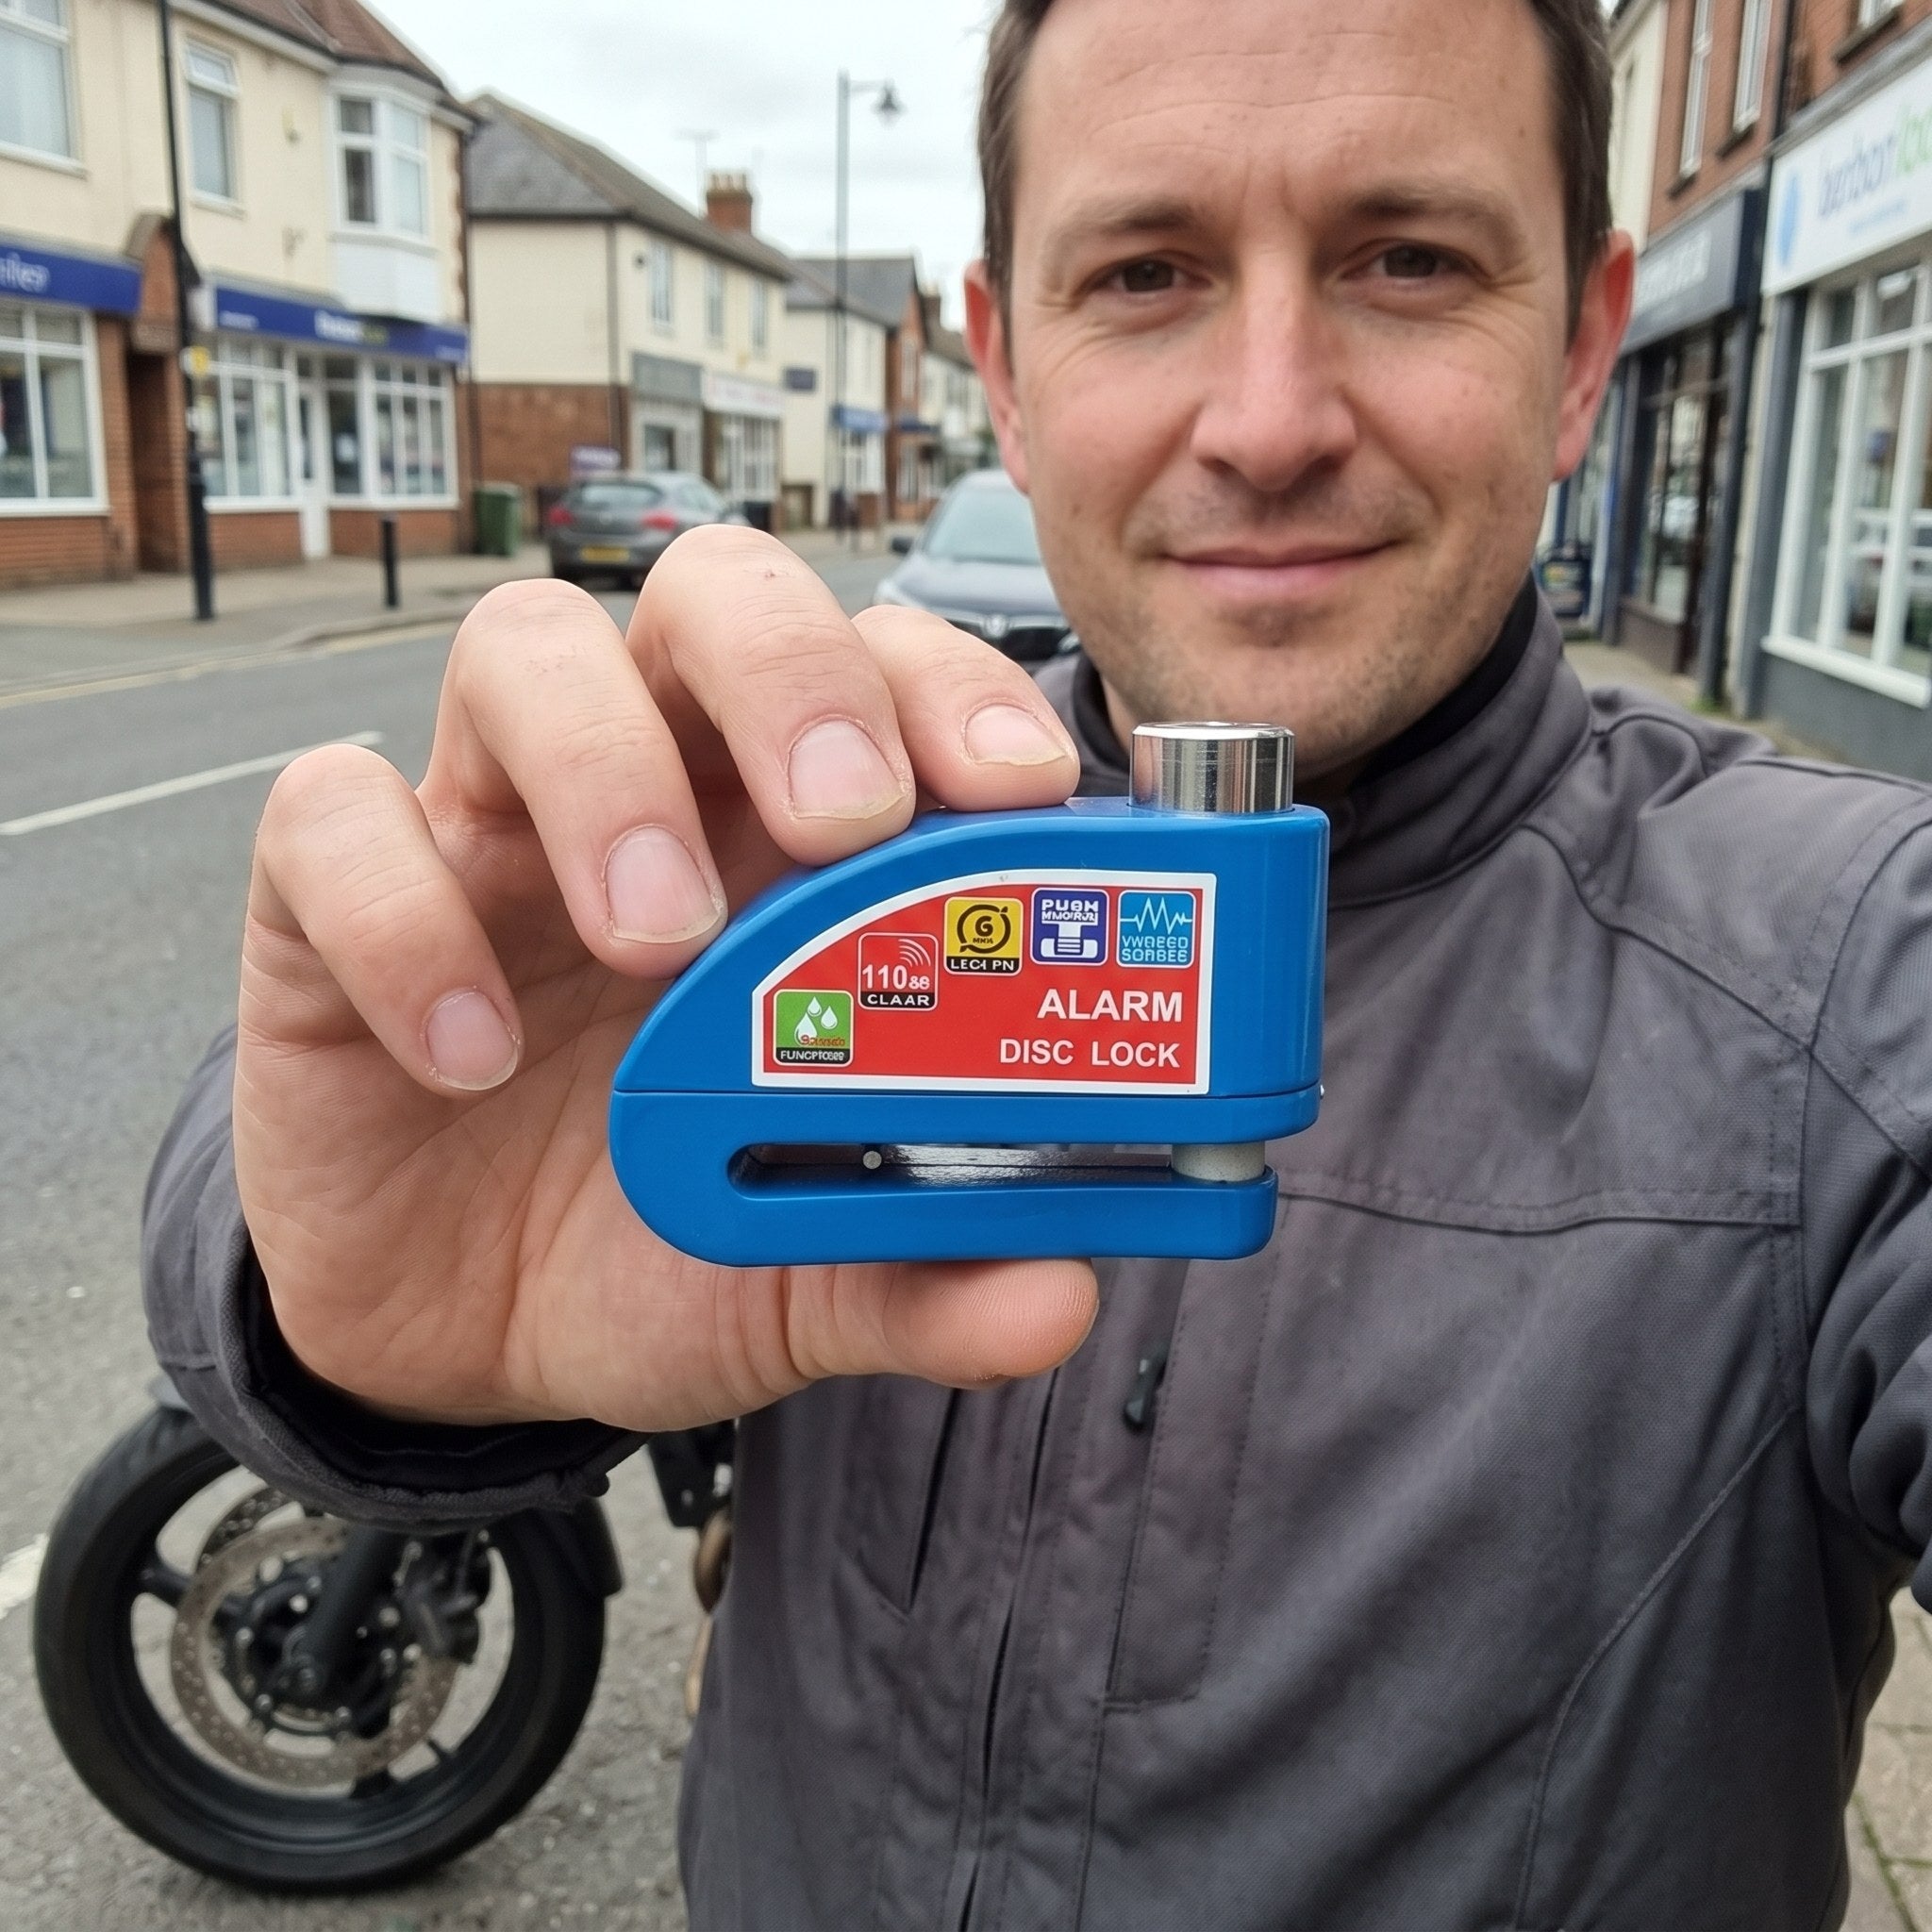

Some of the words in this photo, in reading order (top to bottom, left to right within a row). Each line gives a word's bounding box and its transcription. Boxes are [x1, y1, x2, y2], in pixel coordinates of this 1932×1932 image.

[867, 994, 930, 1007] CLAAR
[1037, 989, 1183, 1022] ALARM
[1000, 1039, 1074, 1065] DISC
[1091, 1041, 1180, 1068] LOCK
